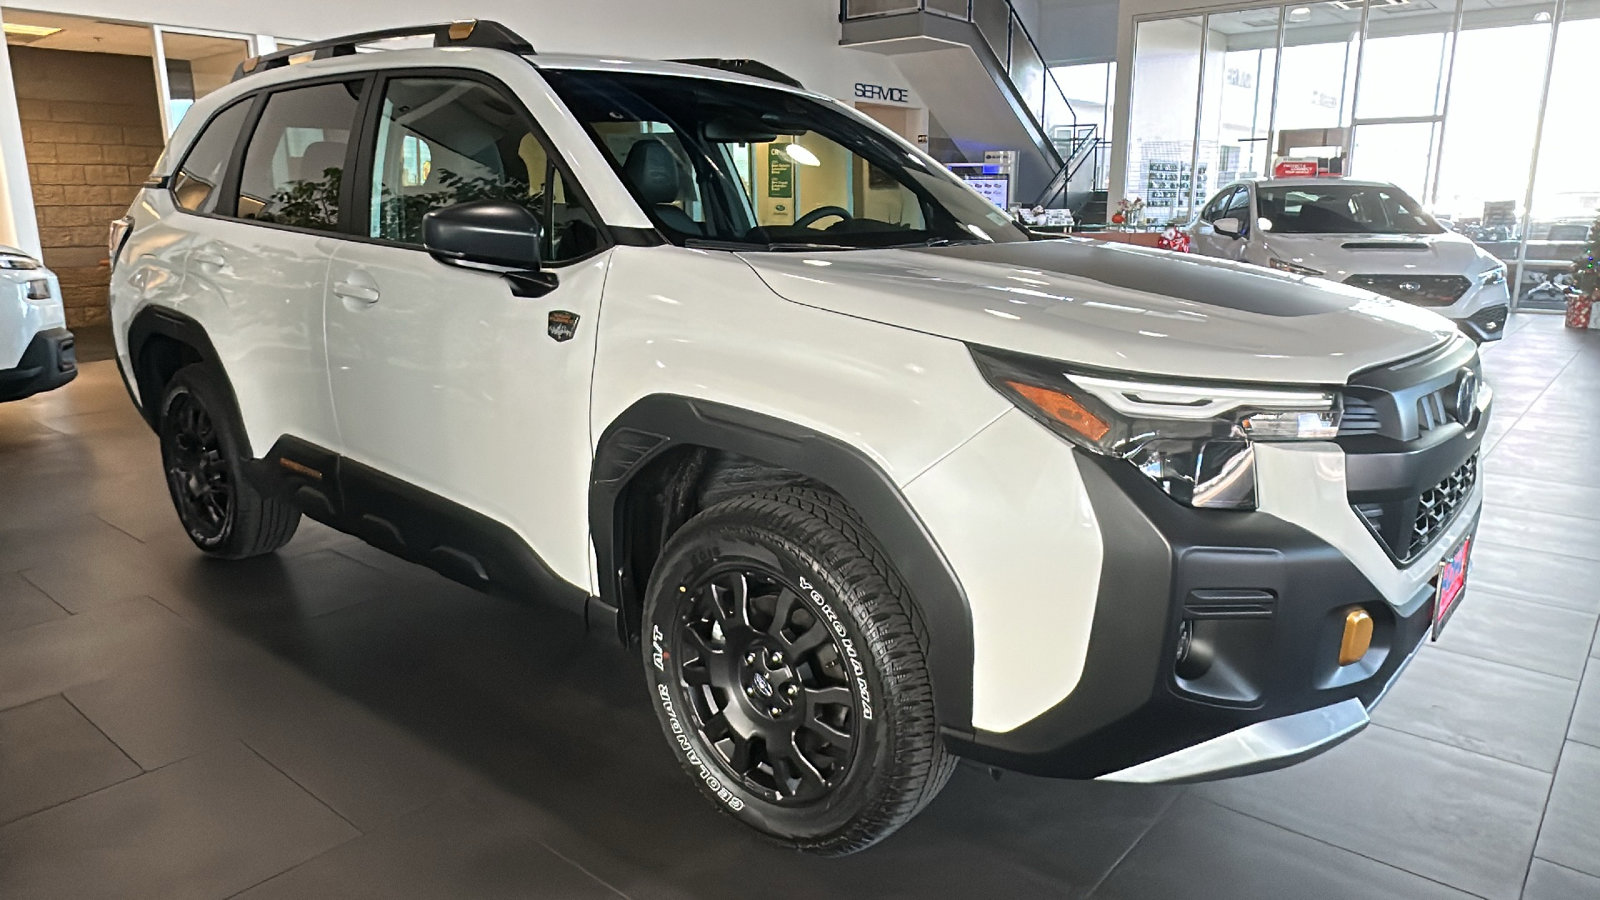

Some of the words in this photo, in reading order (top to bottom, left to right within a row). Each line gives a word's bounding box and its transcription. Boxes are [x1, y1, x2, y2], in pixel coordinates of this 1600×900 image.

[855, 83, 908, 103] SERVICE
[652, 624, 665, 672] A/T
[799, 576, 873, 720] YOKOHAMA
[657, 683, 746, 812] GEOLANDAR
